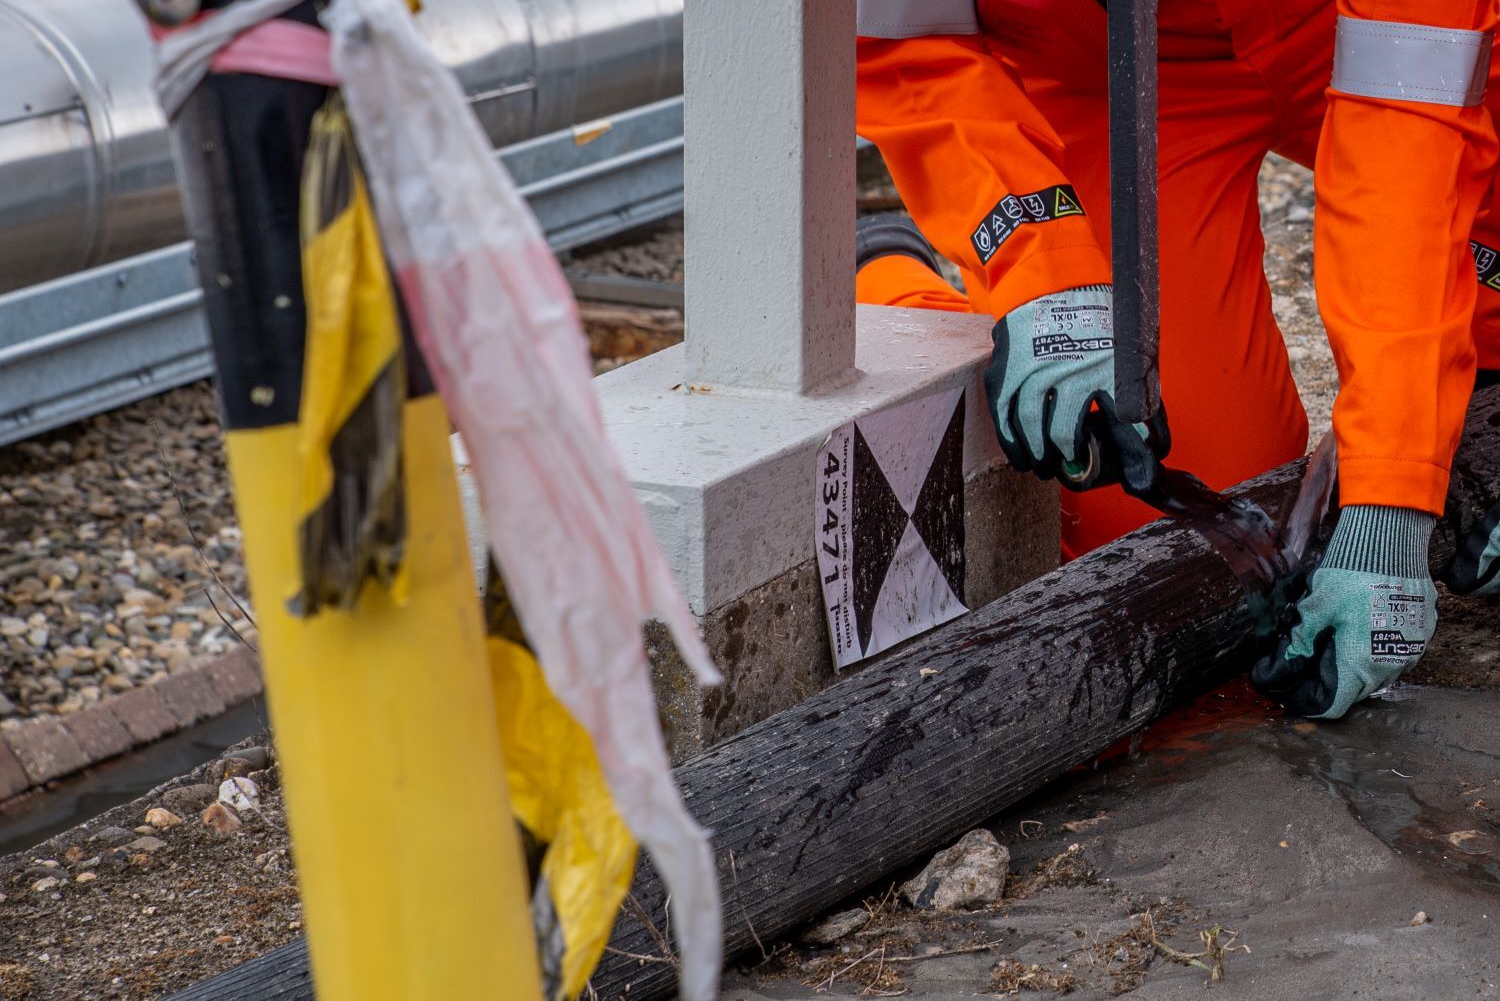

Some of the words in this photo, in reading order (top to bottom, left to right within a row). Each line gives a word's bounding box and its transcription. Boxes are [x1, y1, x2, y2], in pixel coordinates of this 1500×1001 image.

[1051, 313, 1078, 321] 10/XL
[1057, 322, 1073, 331] CE
[1037, 339, 1113, 355] DEXCUT
[842, 437, 850, 478] Survey
[823, 452, 840, 585] 43471
[842, 564, 848, 578] do
[843, 606, 852, 648] disturb
[1392, 615, 1405, 626] CE
